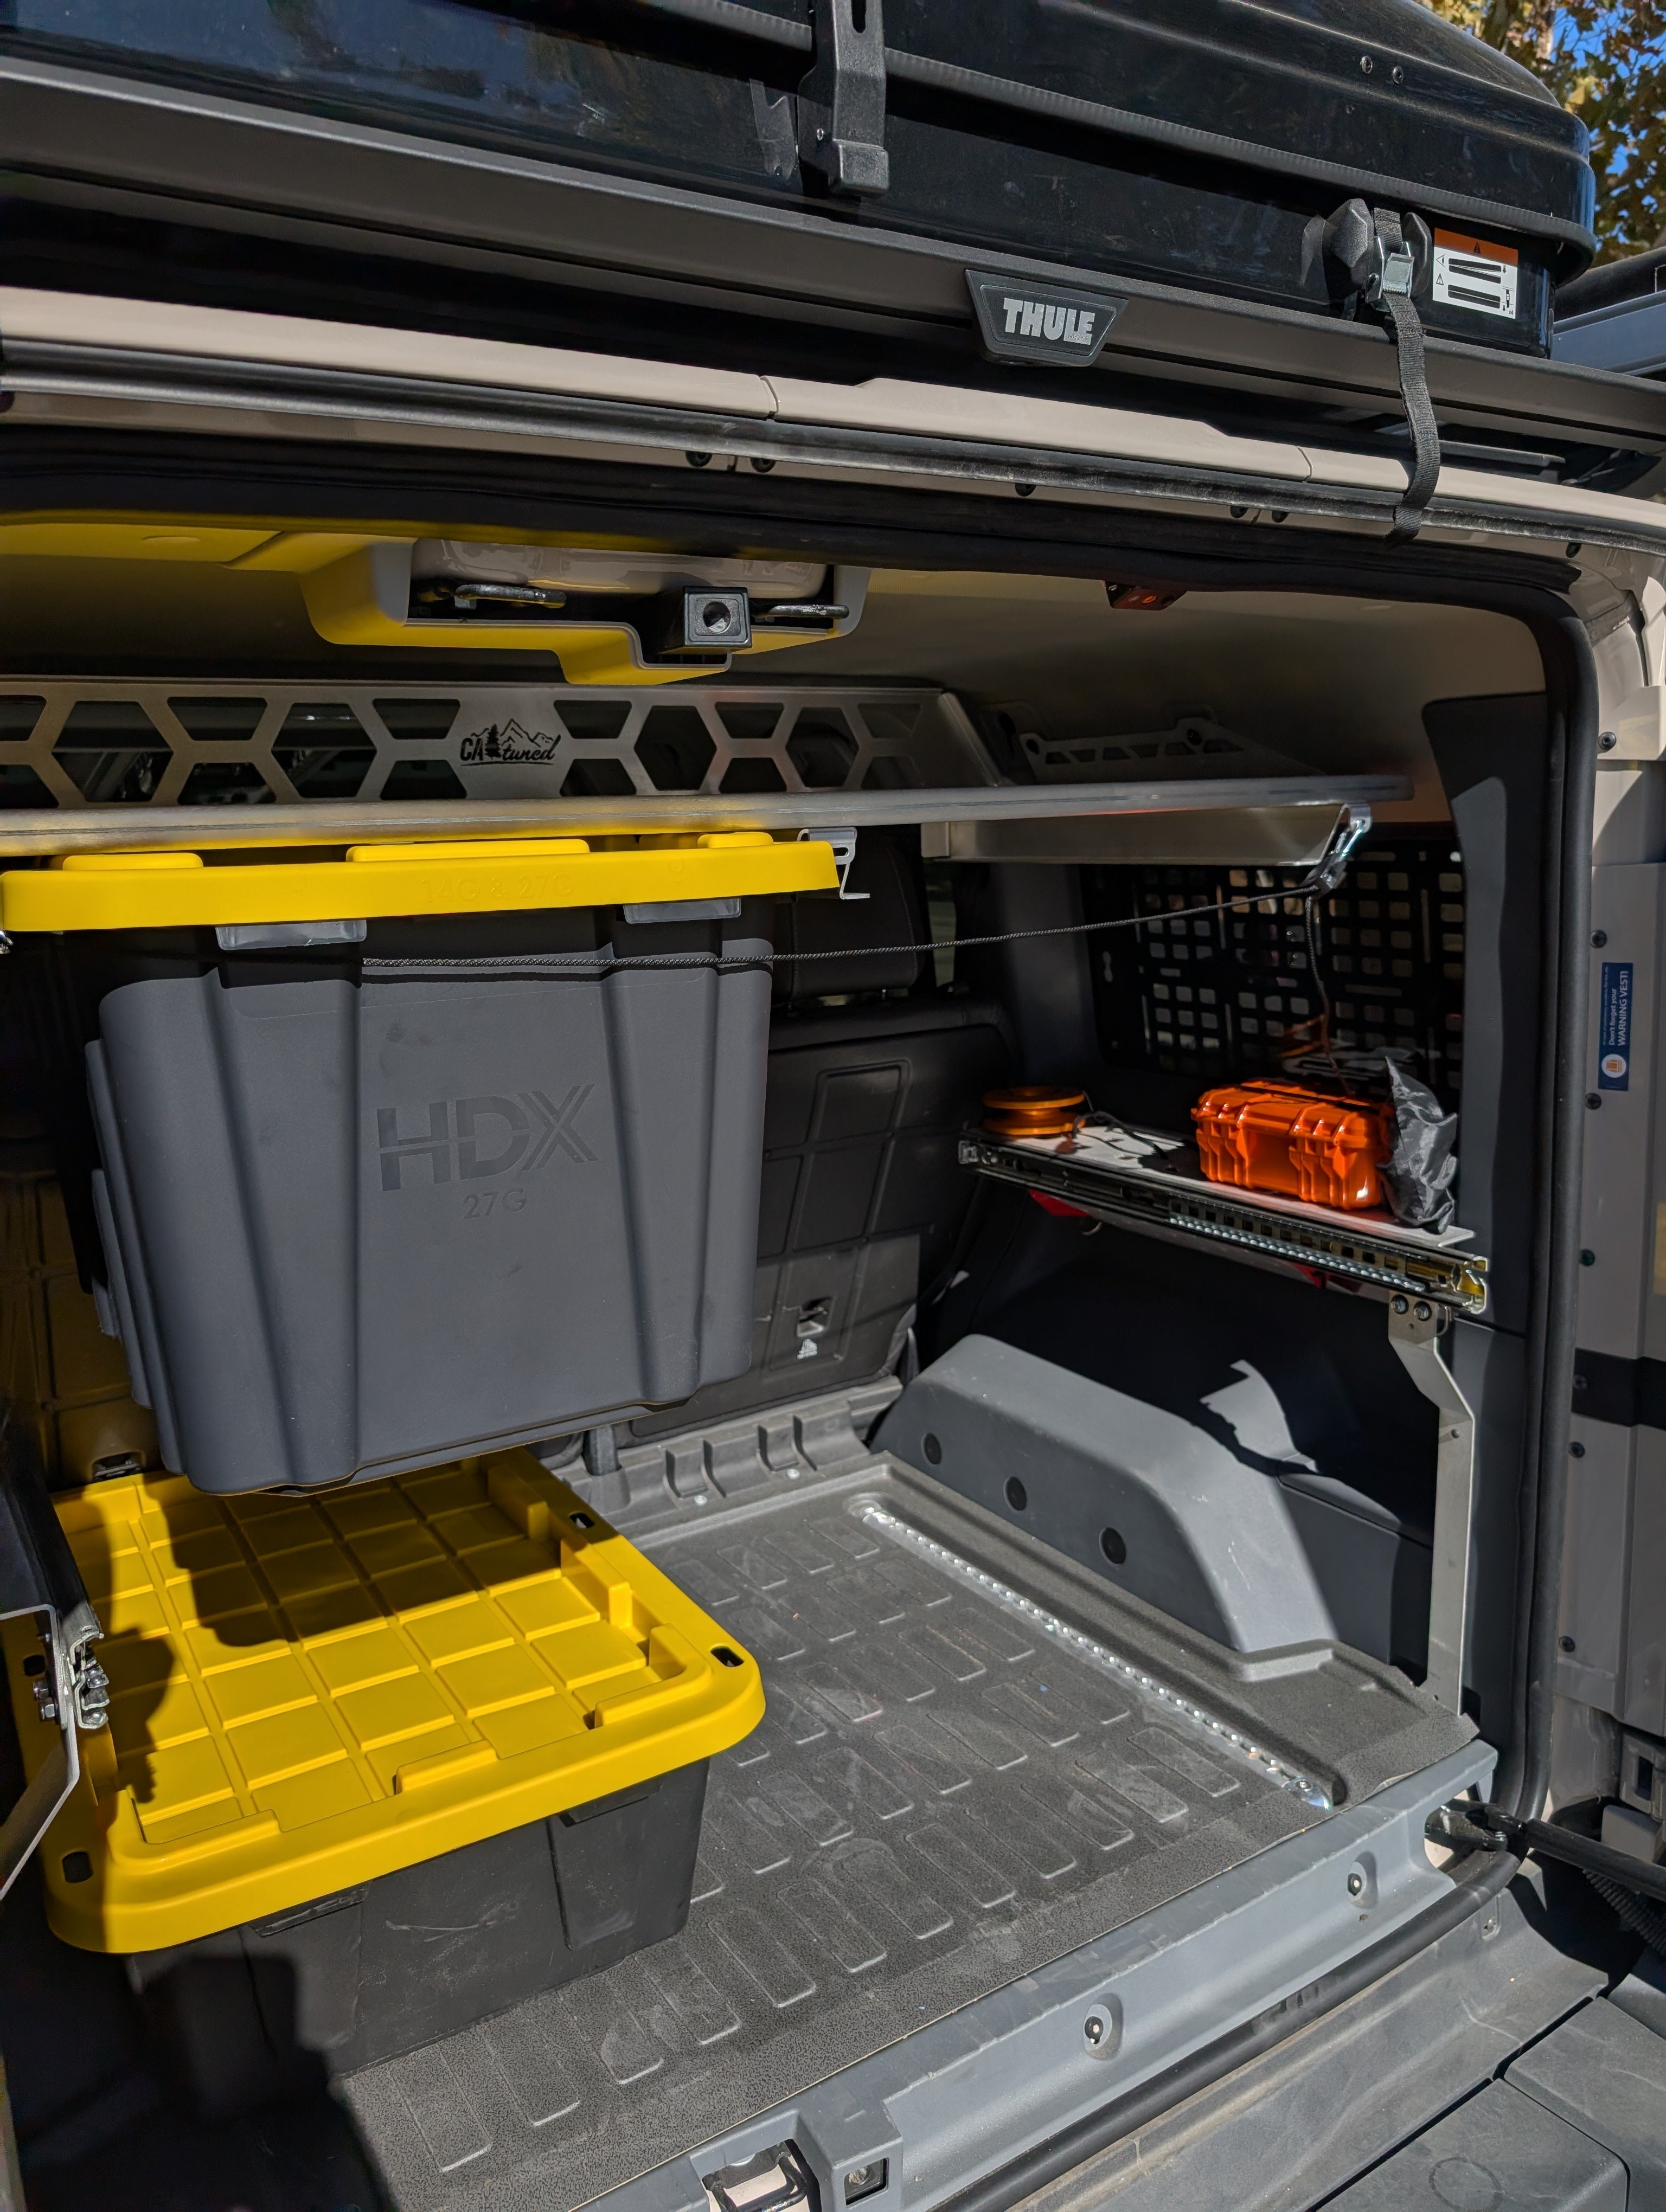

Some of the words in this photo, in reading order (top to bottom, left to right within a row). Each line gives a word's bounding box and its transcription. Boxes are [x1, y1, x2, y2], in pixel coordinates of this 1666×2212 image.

[1003, 298, 1095, 345] THULE
[460, 737, 484, 761] CA
[502, 734, 561, 761] tuned
[421, 876, 480, 903] 14G
[490, 877, 507, 899] &
[518, 873, 575, 899] 27G
[1609, 1005, 1617, 1026] forget
[1618, 999, 1627, 1046] WARNING
[376, 1084, 599, 1192] HDX
[463, 1188, 528, 1220] 27G
